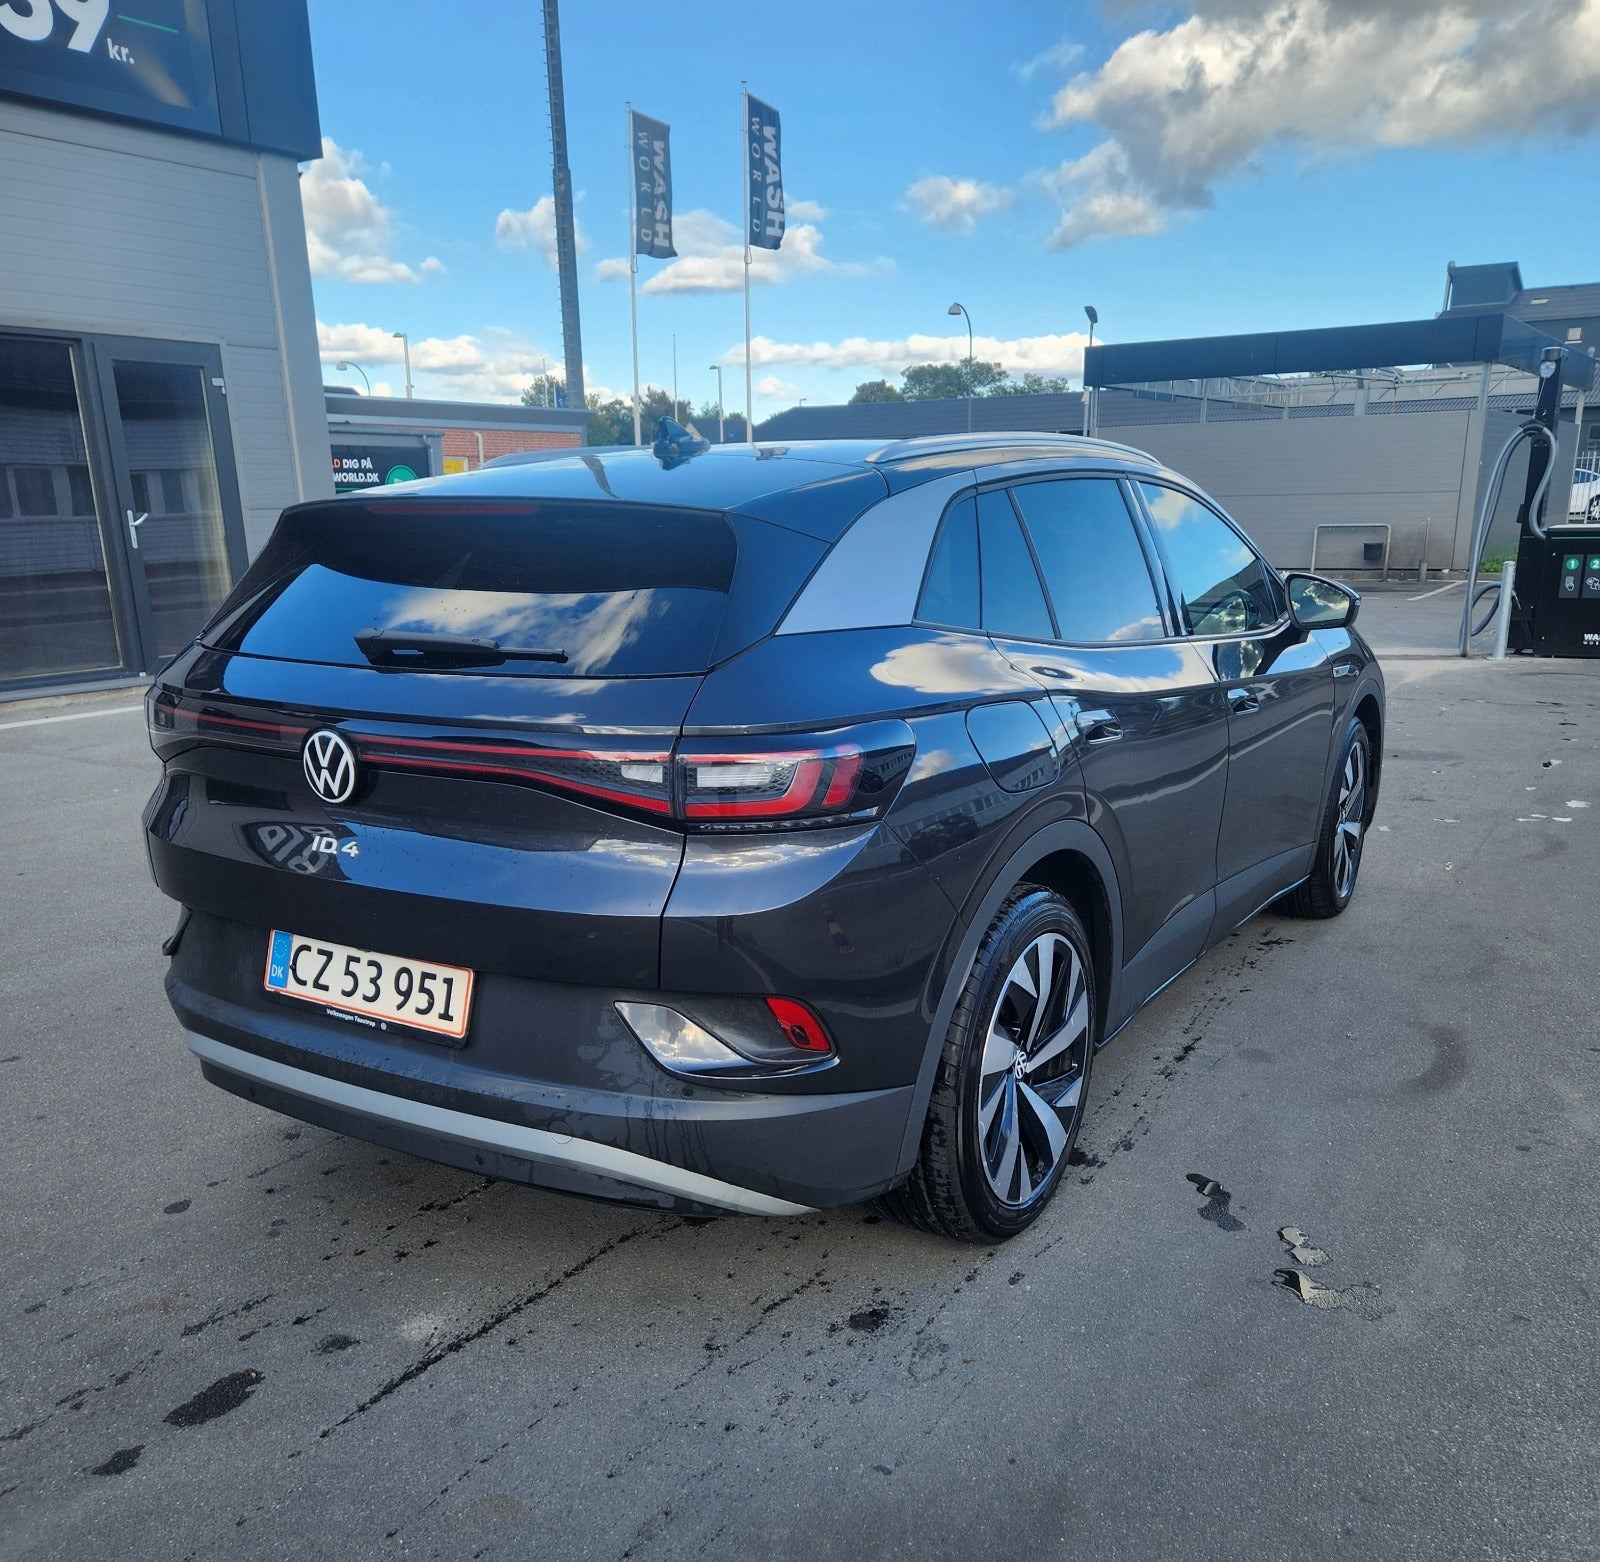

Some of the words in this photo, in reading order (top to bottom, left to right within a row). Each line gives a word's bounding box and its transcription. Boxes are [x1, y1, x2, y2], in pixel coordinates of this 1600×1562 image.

[107, 37, 135, 64] kr.
[638, 132, 652, 242] WORLD
[653, 140, 670, 247] WASH
[751, 117, 762, 233] WORLD
[763, 126, 784, 238] WASH
[342, 458, 359, 469] DIG
[361, 456, 373, 469] PÅ
[271, 964, 284, 979] DK
[291, 944, 334, 992] CZ
[341, 955, 383, 1003] 53
[394, 966, 454, 1022] 951
[326, 1008, 354, 1021] Volkswagen
